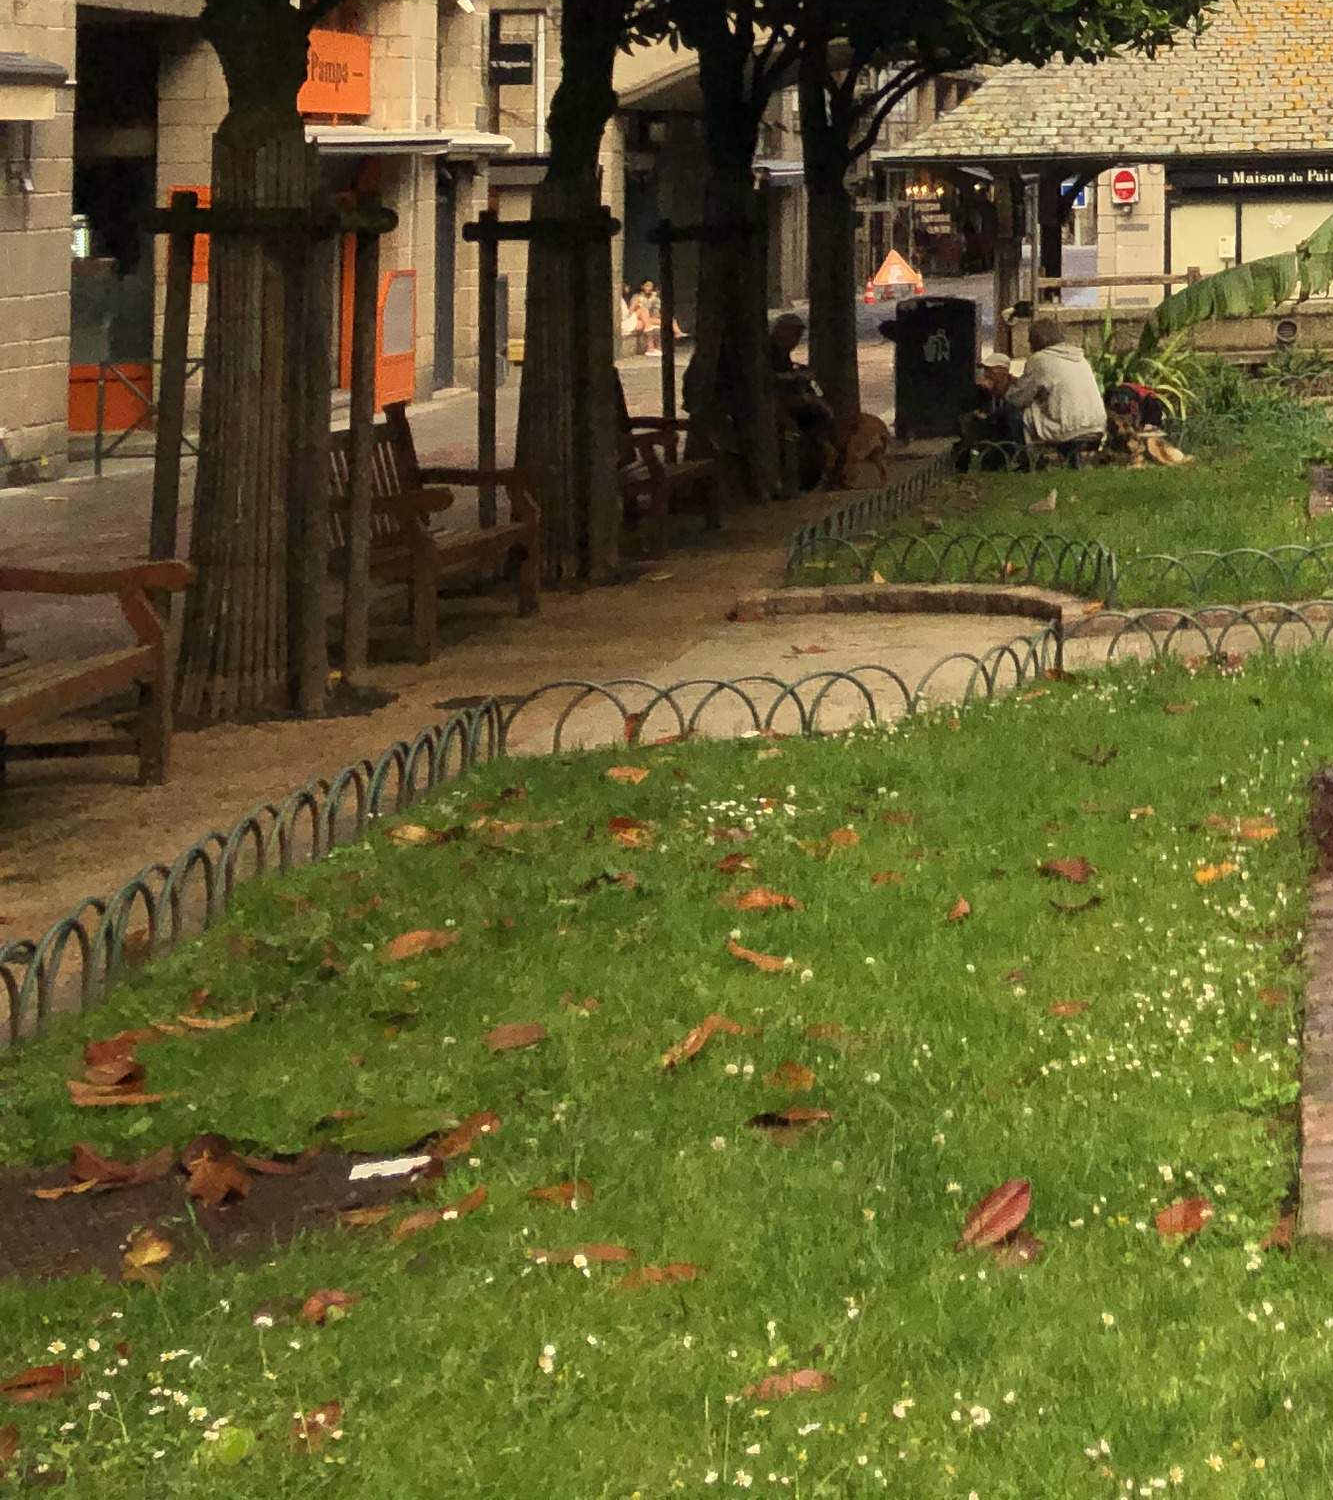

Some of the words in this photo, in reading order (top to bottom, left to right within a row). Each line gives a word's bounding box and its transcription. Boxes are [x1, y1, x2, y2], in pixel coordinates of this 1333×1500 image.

[1217, 174, 1228, 184] la
[1232, 171, 1285, 184] Maison
[1289, 172, 1303, 182] du
